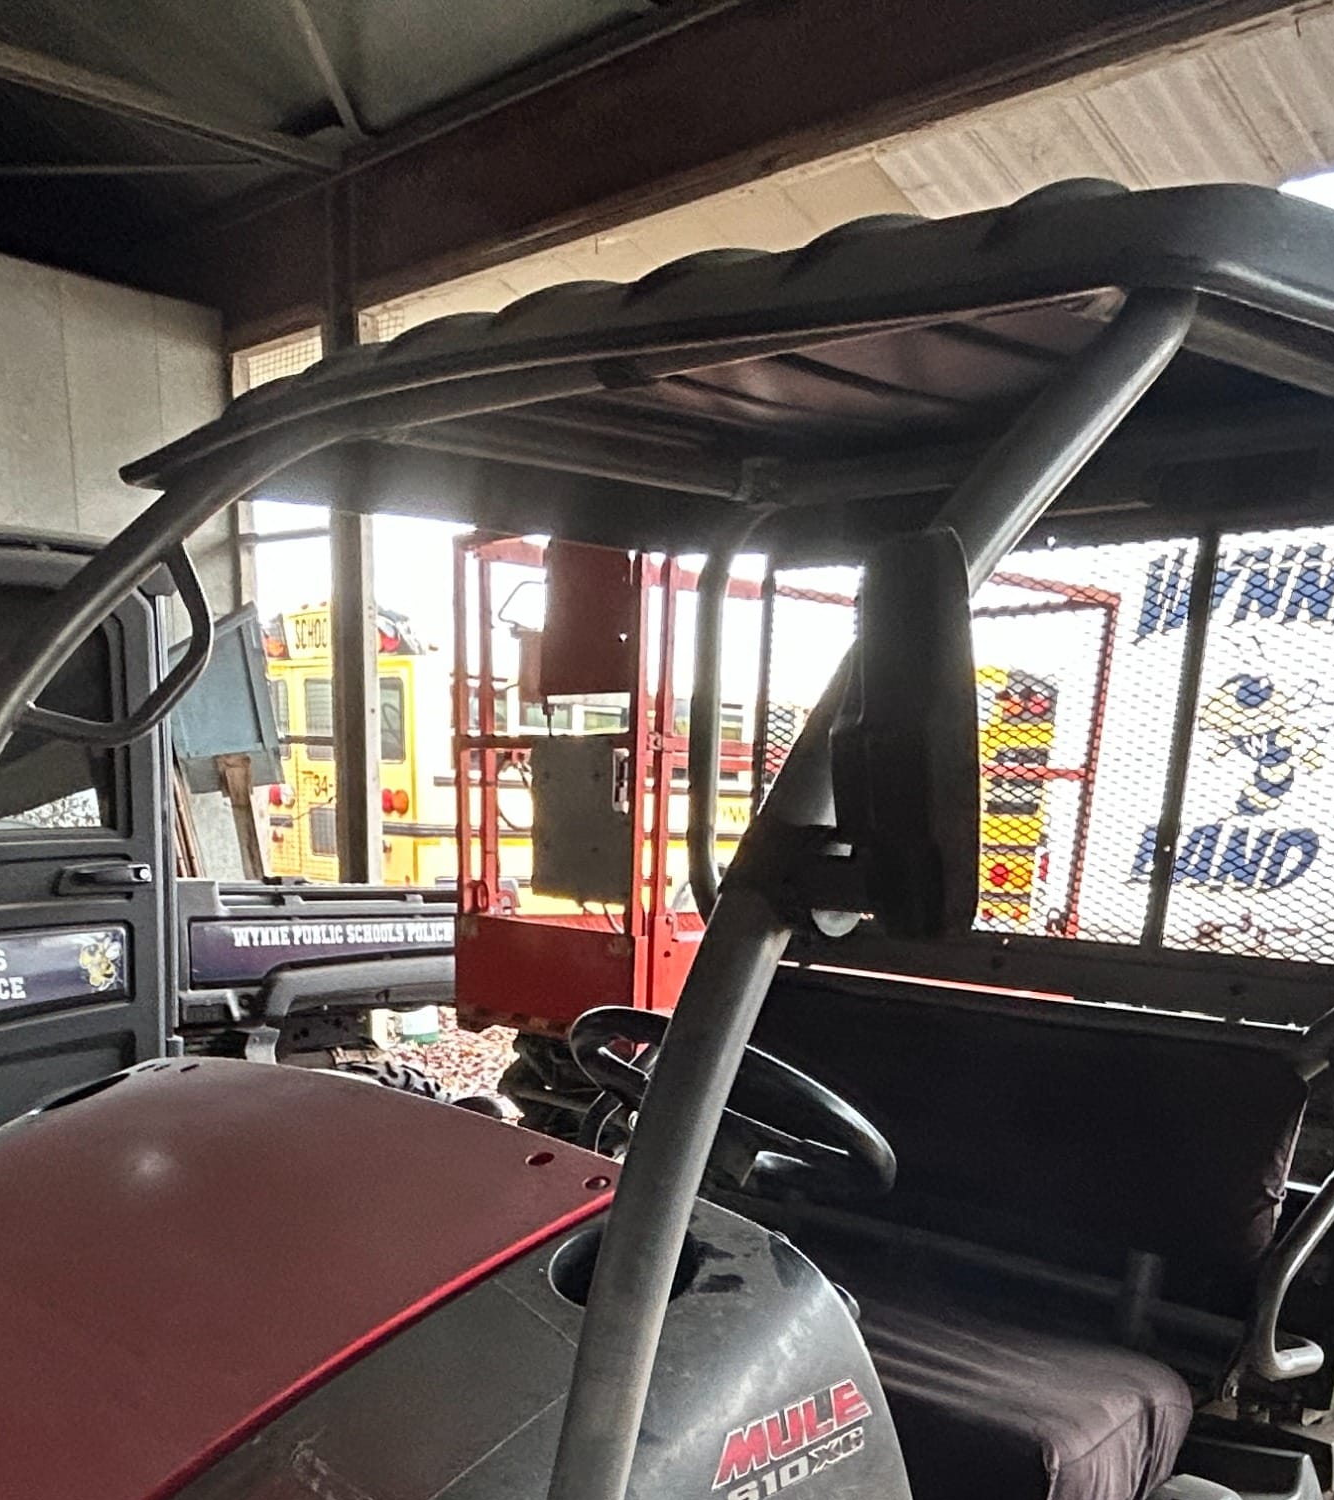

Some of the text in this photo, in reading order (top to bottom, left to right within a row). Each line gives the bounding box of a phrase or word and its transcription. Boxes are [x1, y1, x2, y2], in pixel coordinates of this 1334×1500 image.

[232, 926, 291, 947] WYNNE
[291, 924, 344, 945] PUBLIC
[346, 923, 405, 944] SCHOOLS
[711, 1377, 872, 1491] MULE
